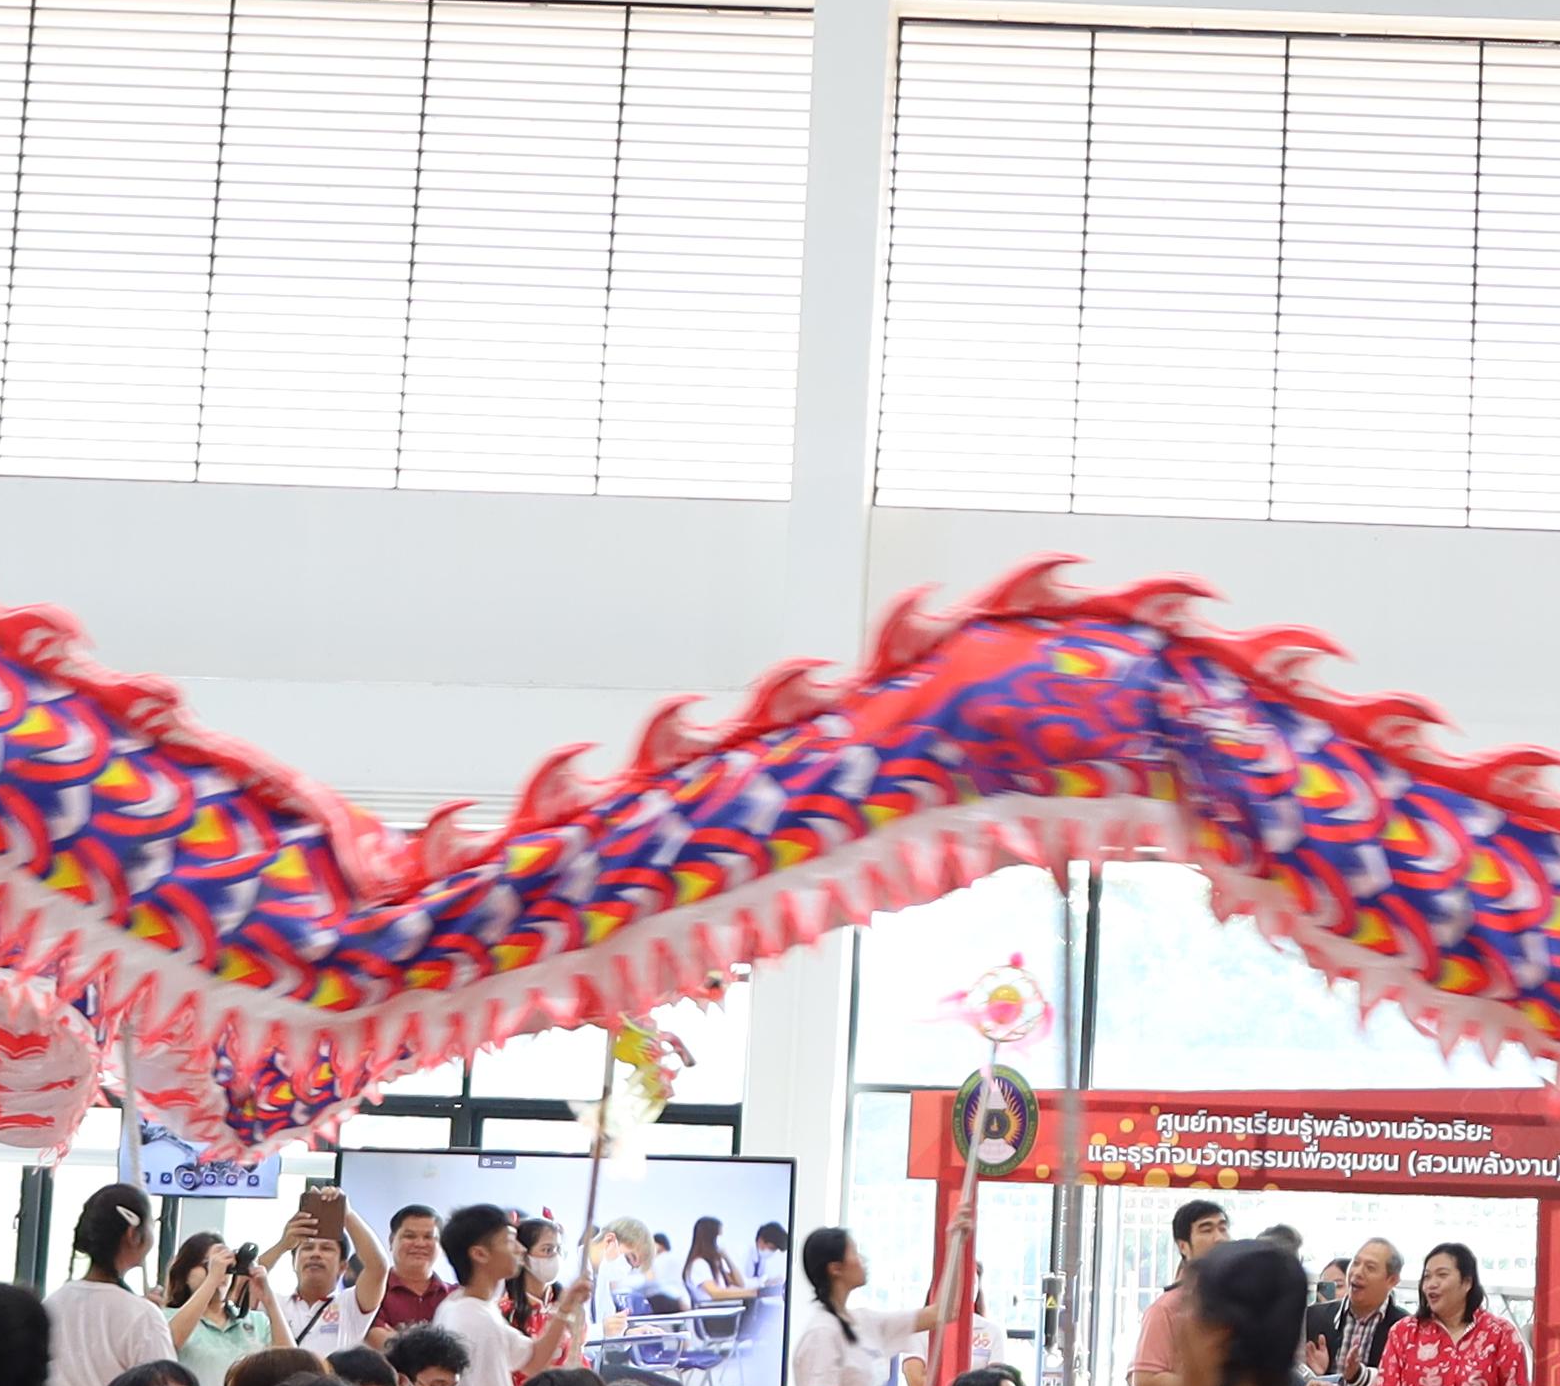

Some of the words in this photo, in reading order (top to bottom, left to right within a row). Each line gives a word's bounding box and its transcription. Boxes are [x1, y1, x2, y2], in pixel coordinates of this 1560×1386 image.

[1156, 1109, 1492, 1142] ศูนย์การเรียนรู้พลังงานอัจฉริยะ
[1088, 1140, 1400, 1178] และธุรกิจนวัตกรรมเพื่อชุมชน
